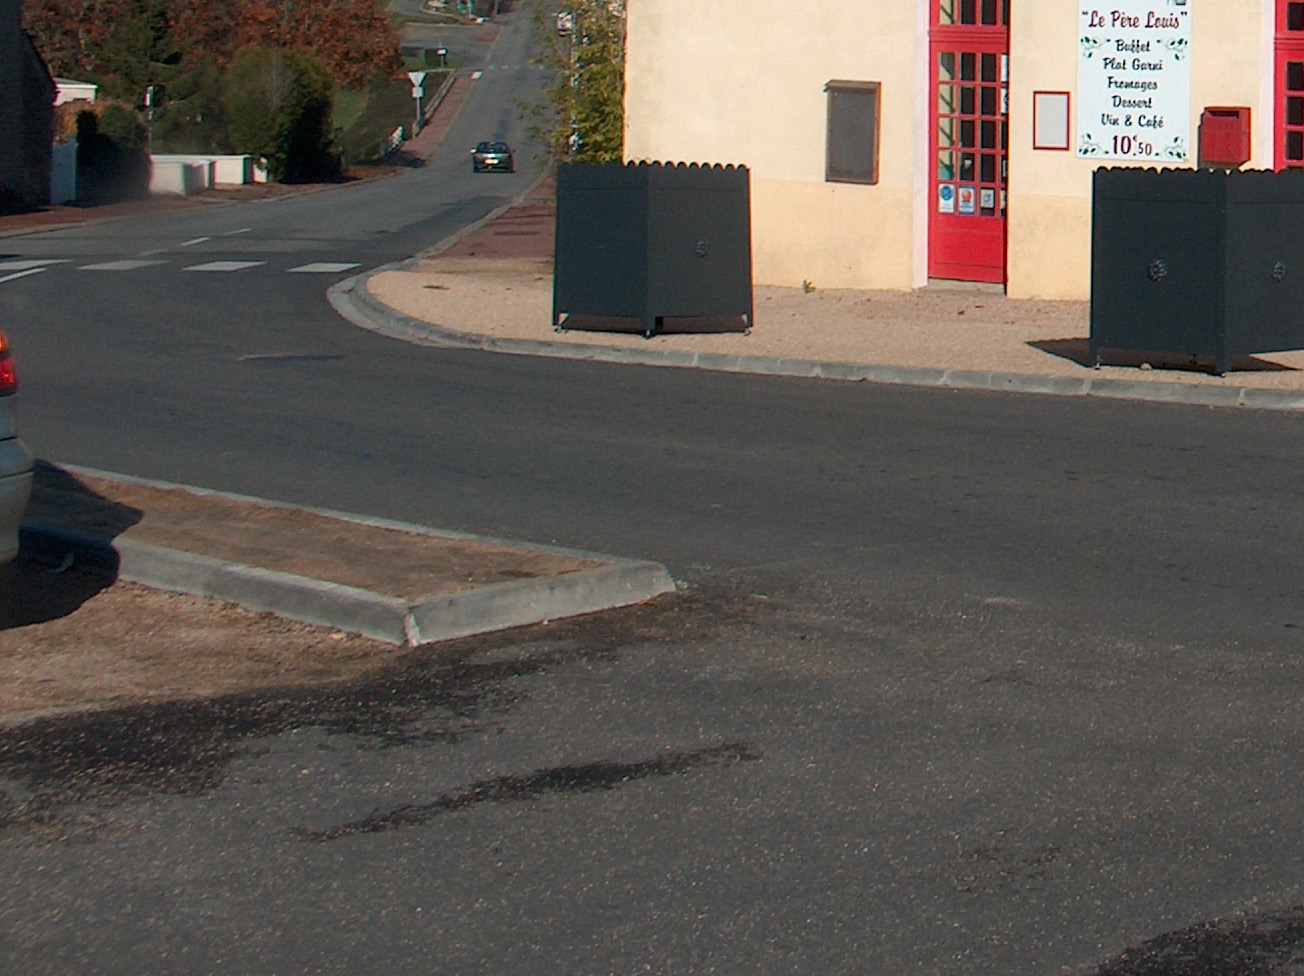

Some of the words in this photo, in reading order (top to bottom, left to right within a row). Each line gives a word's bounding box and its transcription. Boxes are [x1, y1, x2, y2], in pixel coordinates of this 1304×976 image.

[1111, 10, 1141, 28] Père
[1115, 39, 1151, 54] Buffet
[1102, 58, 1127, 71] Plat
[1132, 58, 1163, 71] Garni
[1107, 76, 1158, 92] Fromages
[1111, 95, 1153, 109] Dessert
[1101, 113, 1120, 126] Vin
[1124, 115, 1133, 127] &
[1138, 115, 1165, 129] Café
